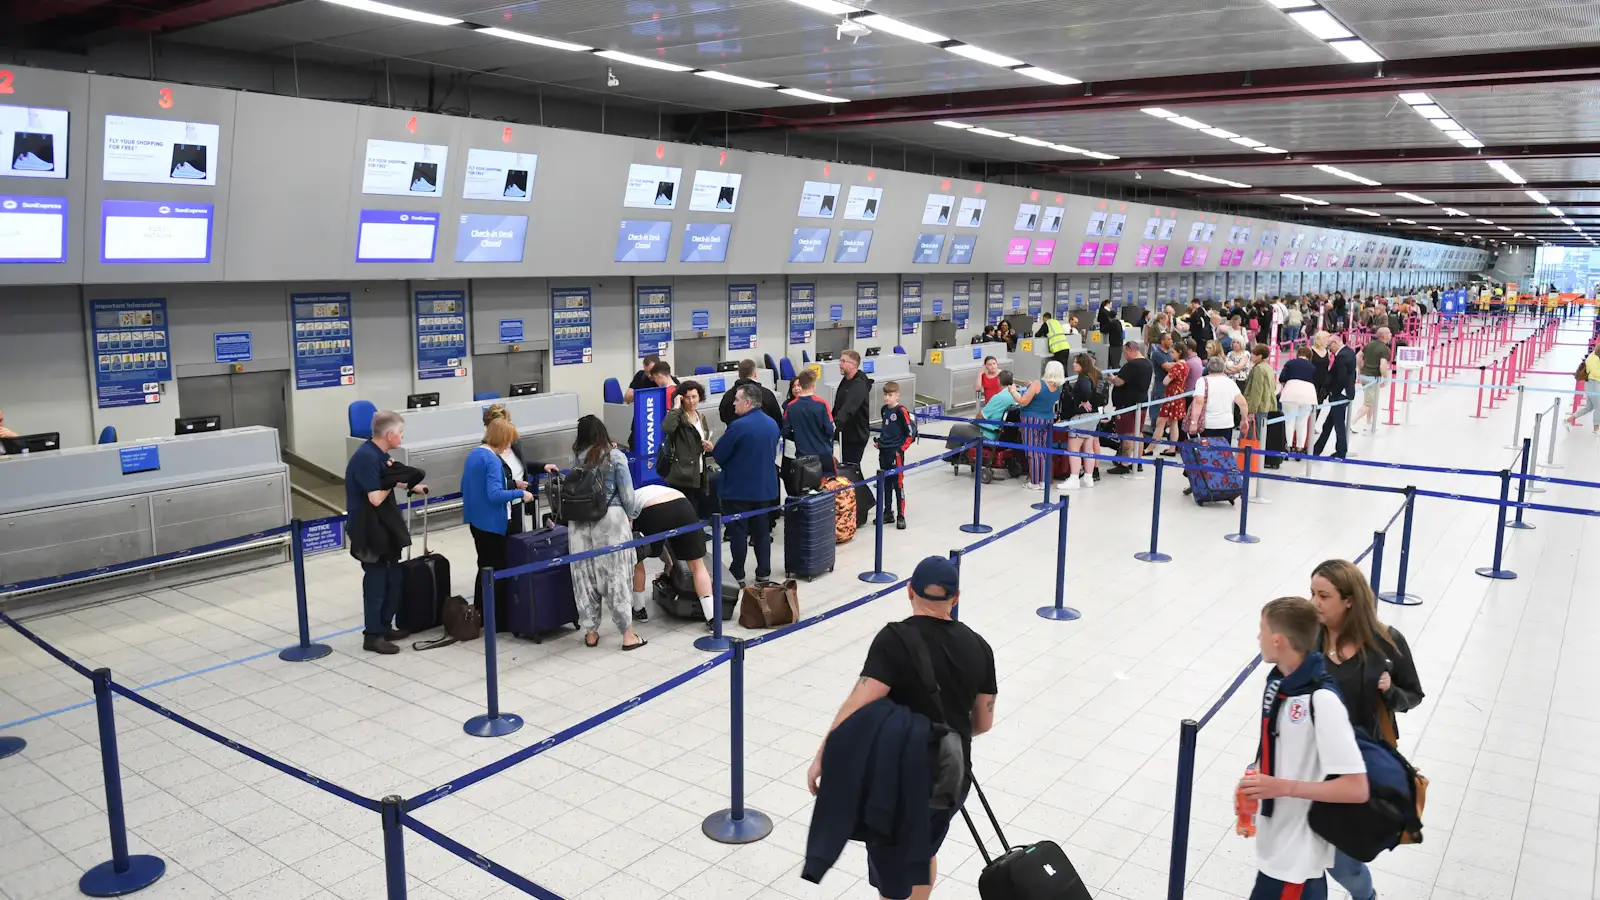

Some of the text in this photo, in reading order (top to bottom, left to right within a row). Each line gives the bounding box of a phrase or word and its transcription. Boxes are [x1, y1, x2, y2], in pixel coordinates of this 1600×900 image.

[0, 70, 15, 94] 2
[158, 88, 173, 108] 3
[406, 116, 417, 133] 4
[22, 202, 62, 210] SunExpress
[174, 207, 208, 215] SunExpress
[471, 229, 514, 239] Check-in Desk
[628, 233, 649, 241] Check-in
[480, 239, 502, 248] Closed
[635, 241, 651, 249] Closed
[95, 301, 161, 310] Important Information
[647, 397, 655, 460] RYANAIR
[309, 523, 330, 533] NOTICE
